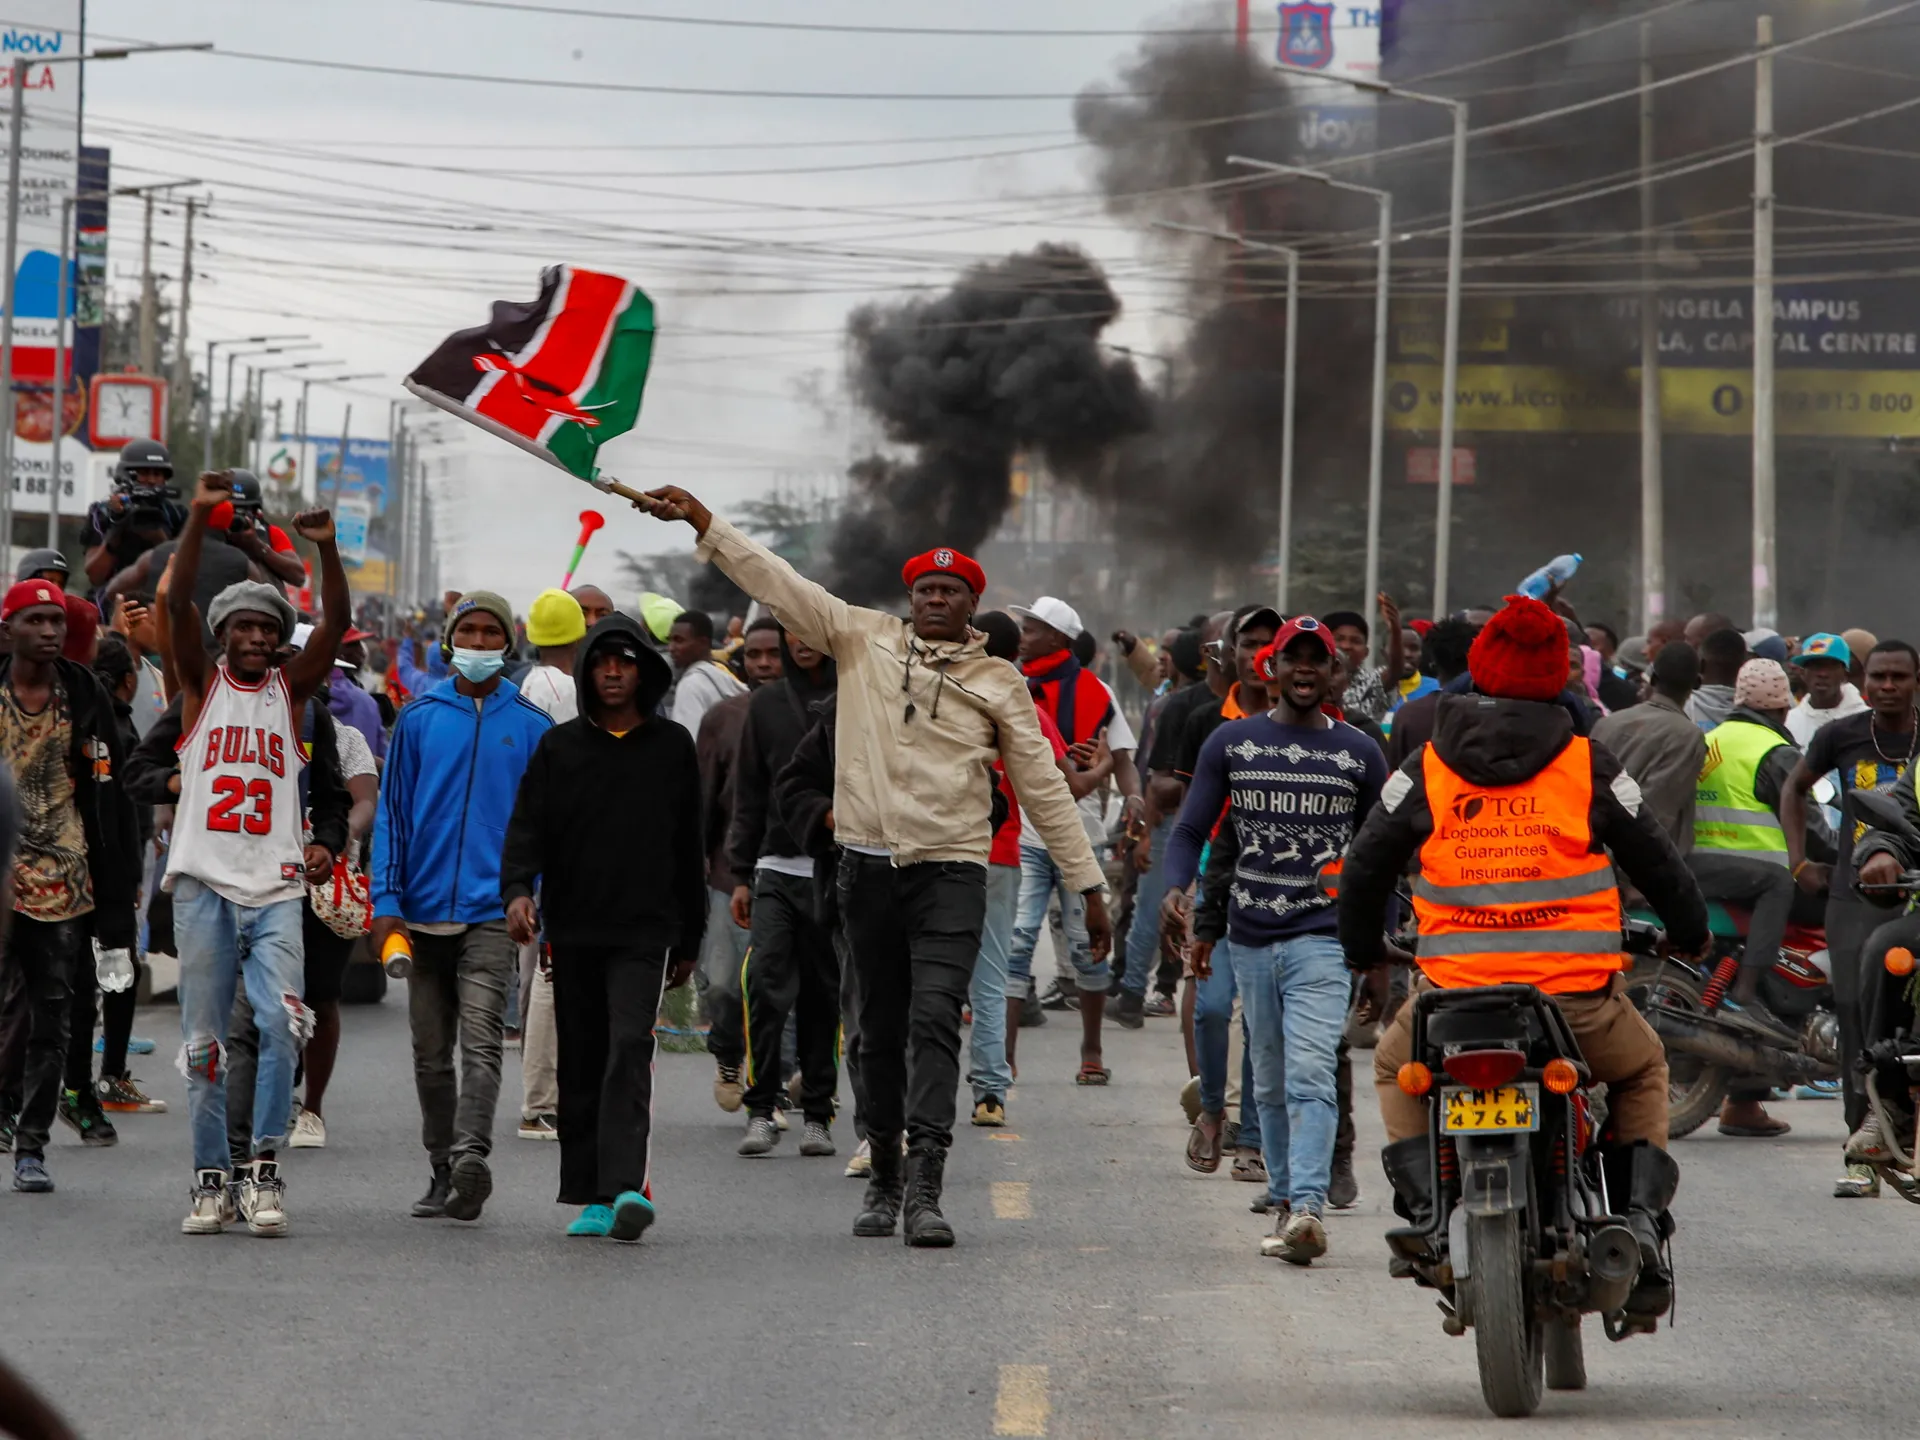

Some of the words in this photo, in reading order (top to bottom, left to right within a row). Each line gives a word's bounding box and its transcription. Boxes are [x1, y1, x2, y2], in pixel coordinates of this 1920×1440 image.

[3, 29, 62, 53] NOW
[1764, 299, 1861, 320] AMPUS
[1819, 331, 1917, 355] CENTRE
[1868, 393, 1913, 412] 800
[203, 725, 285, 779] BULLS
[206, 774, 273, 836] 23
[1242, 789, 1266, 811] HO
[1270, 791, 1297, 814] HO
[1300, 792, 1328, 815] HO
[1489, 796, 1545, 817] TGL
[1441, 825, 1509, 842] Logbook
[1514, 823, 1561, 838] Loans
[1454, 844, 1548, 859] Guarantees
[1460, 865, 1542, 880] Insurance
[1451, 1109, 1529, 1128] 476W
